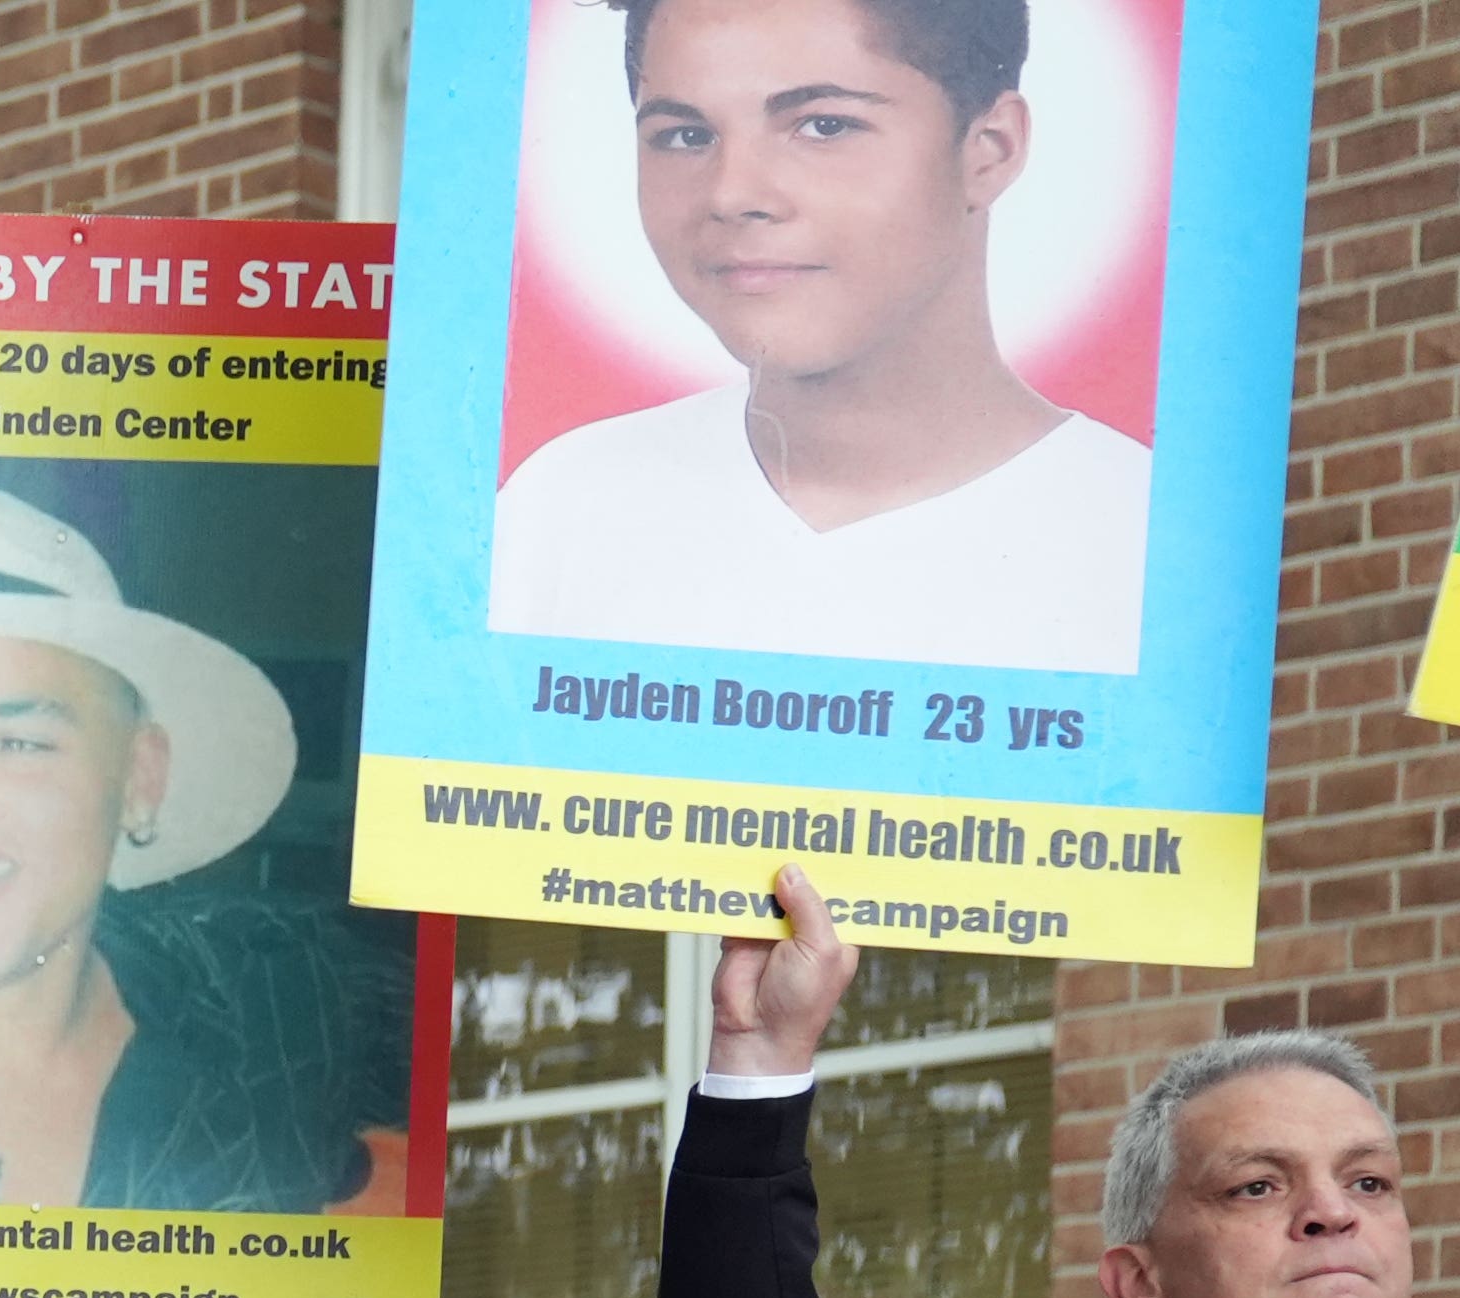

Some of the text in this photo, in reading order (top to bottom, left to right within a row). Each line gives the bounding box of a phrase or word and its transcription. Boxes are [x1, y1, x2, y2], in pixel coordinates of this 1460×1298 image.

[0, 342, 49, 374] 20
[61, 344, 156, 383] days
[167, 346, 212, 379] of
[115, 407, 253, 442] Center
[532, 665, 1084, 751] Jayden Booroff 23 yrs
